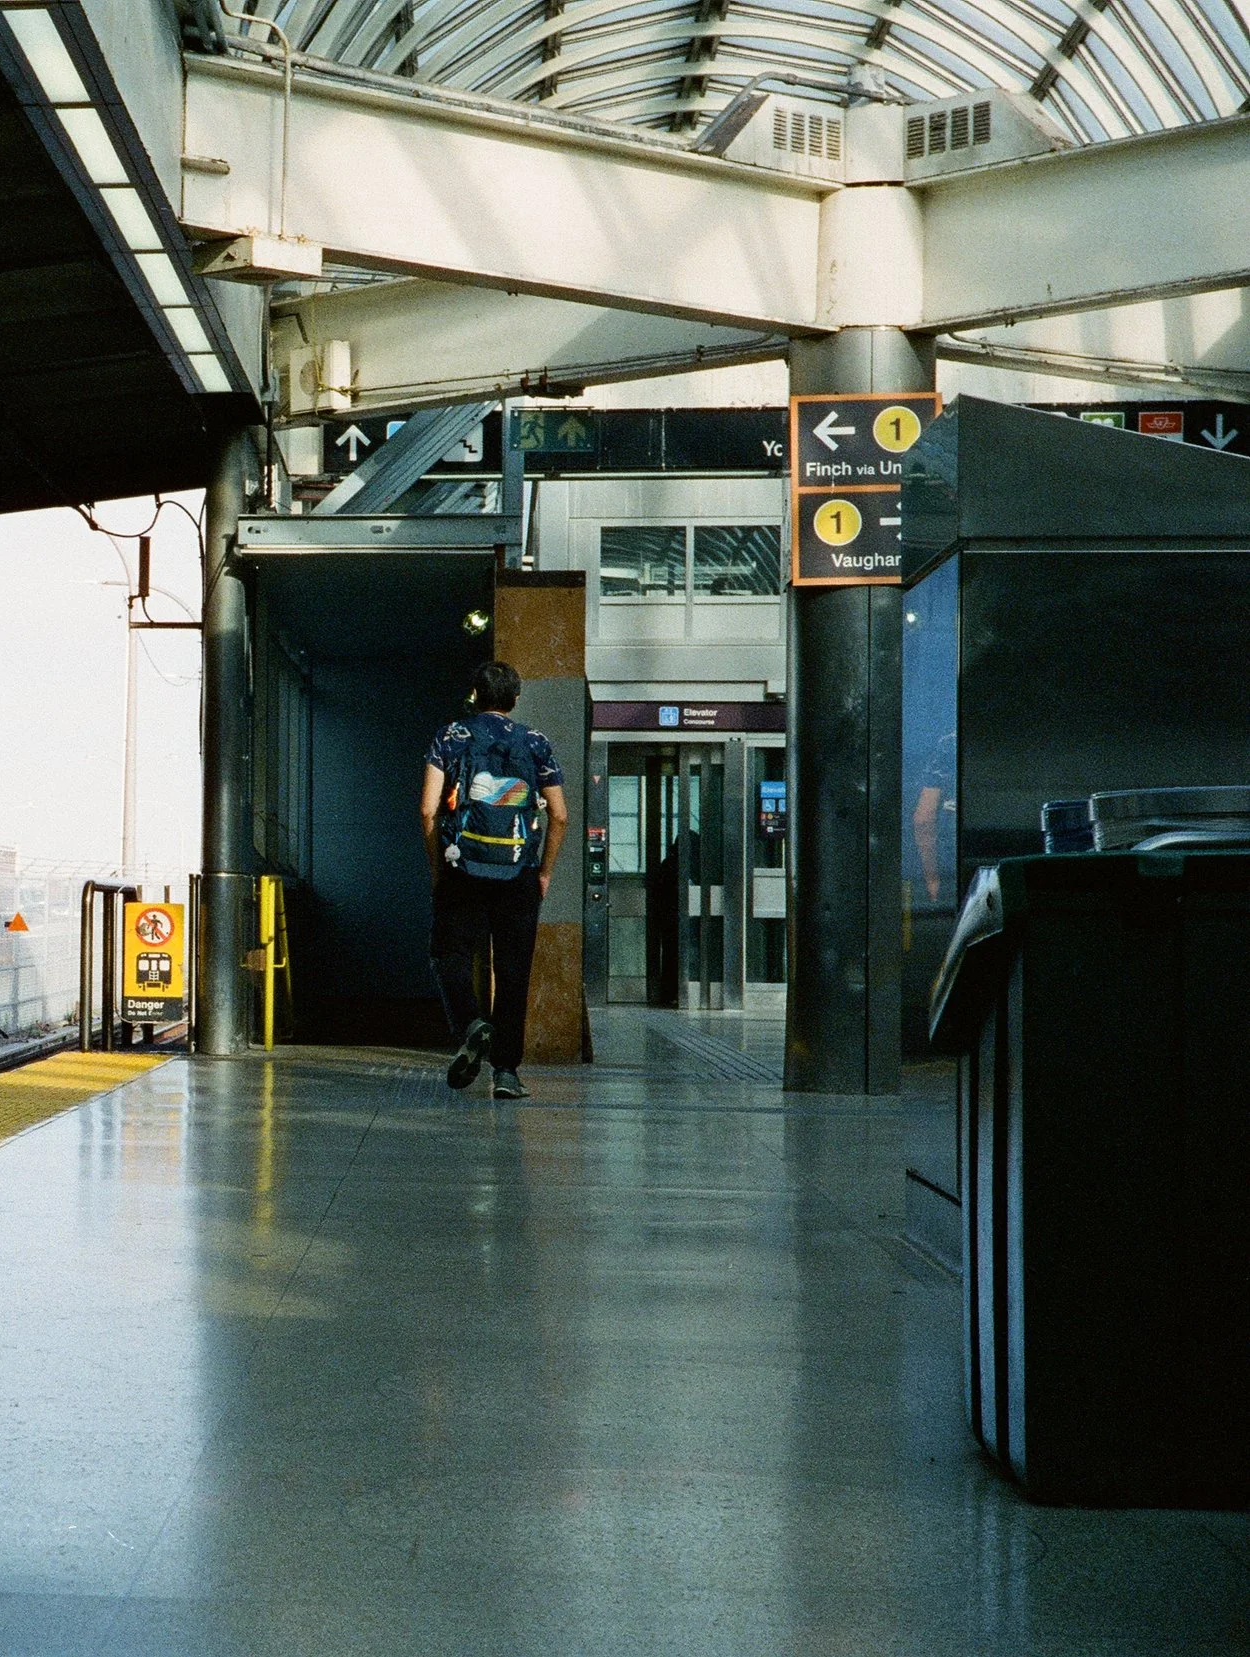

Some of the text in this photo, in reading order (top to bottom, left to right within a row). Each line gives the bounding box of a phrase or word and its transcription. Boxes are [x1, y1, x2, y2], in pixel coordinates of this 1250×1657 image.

[890, 417, 901, 441] 1
[806, 461, 852, 476] Finch
[856, 464, 875, 475] via
[830, 511, 842, 534] 1
[128, 999, 164, 1010] Danger
